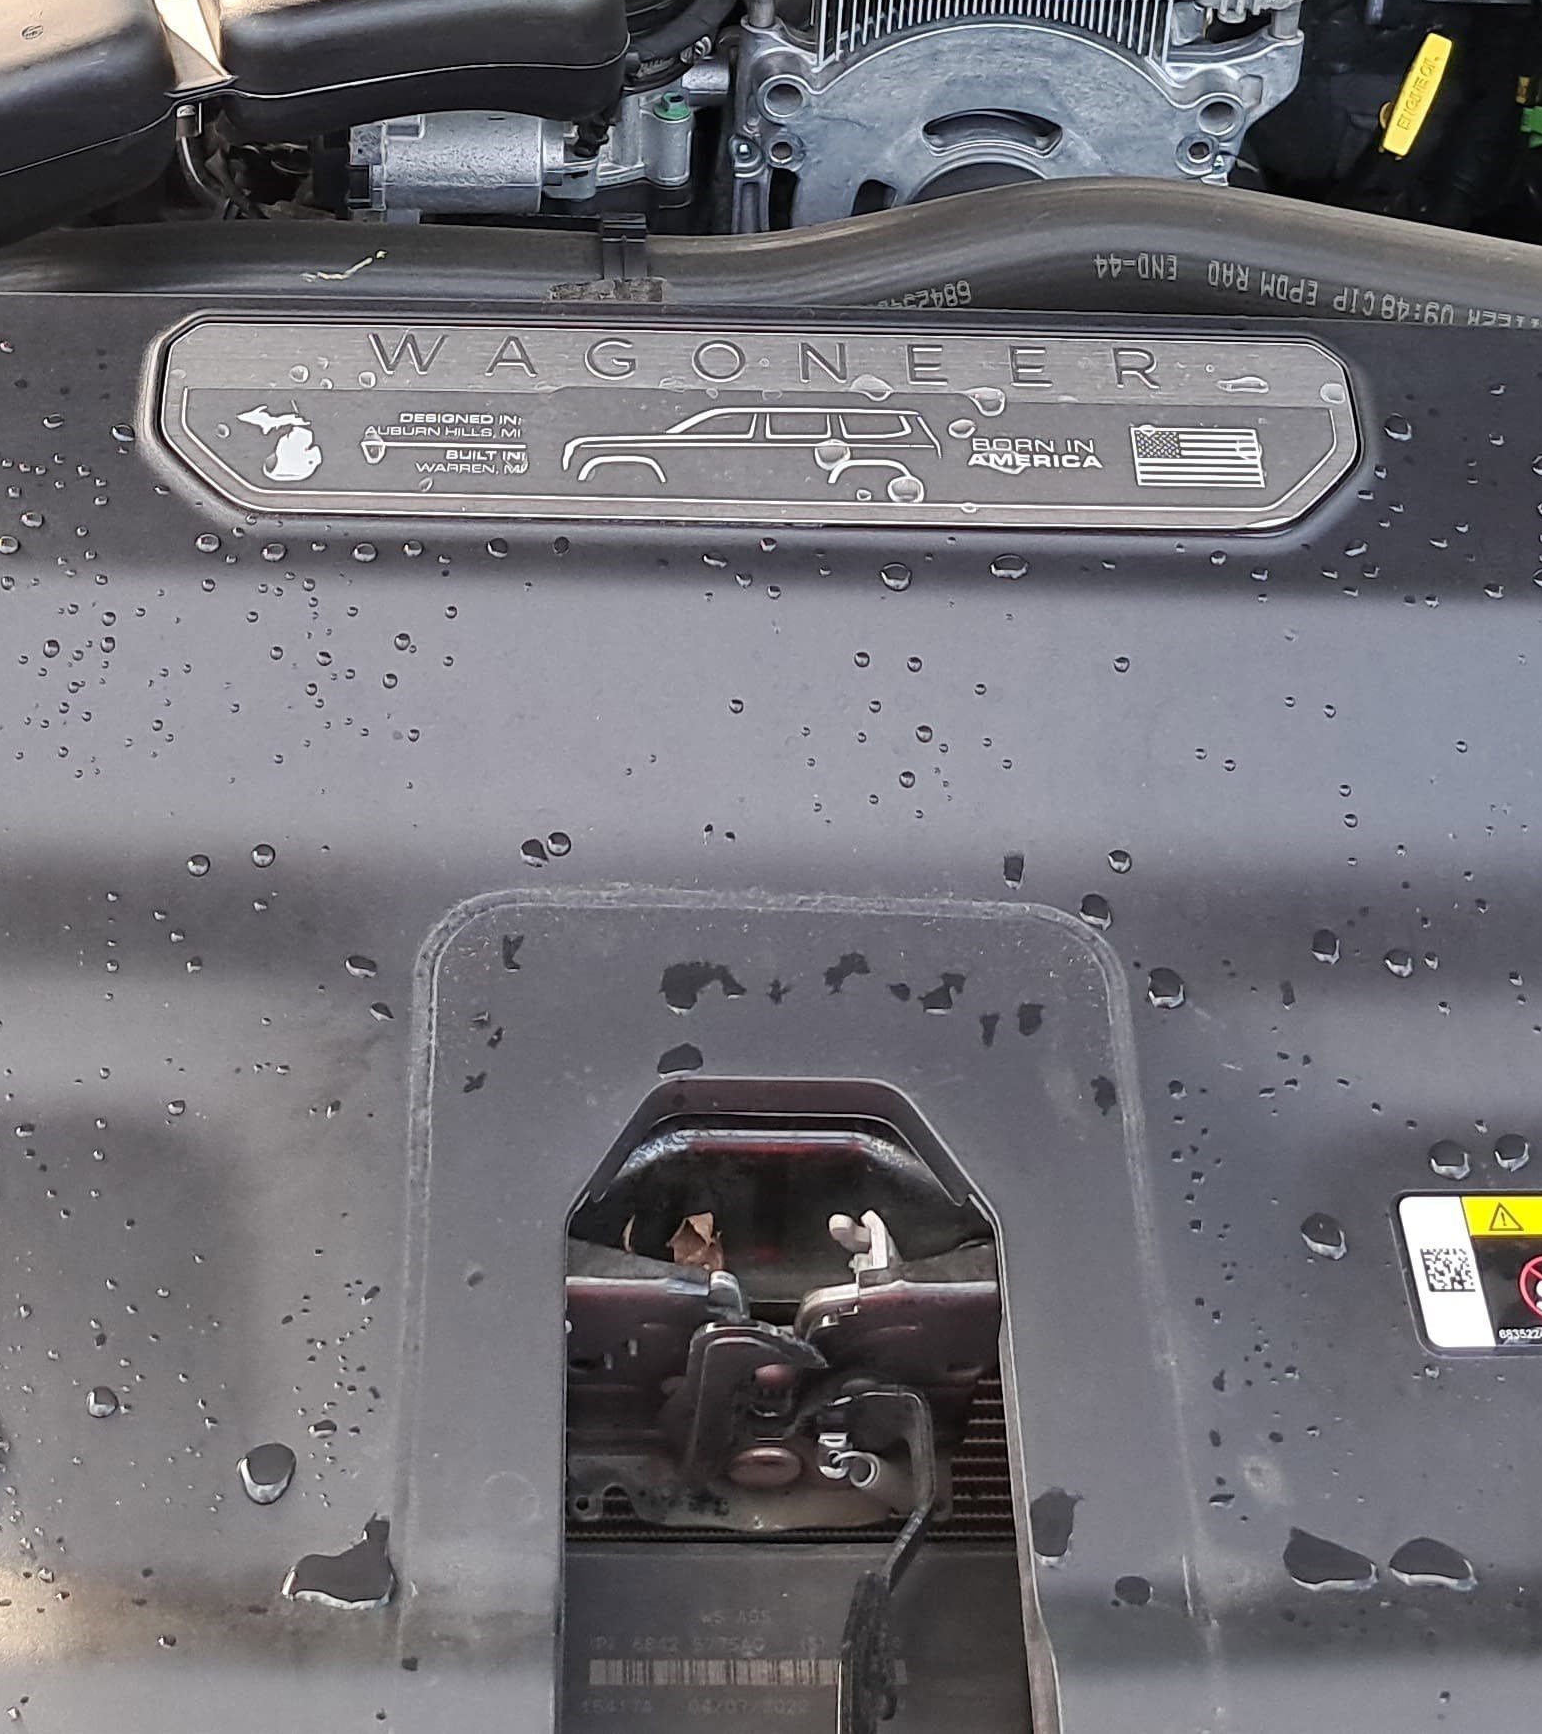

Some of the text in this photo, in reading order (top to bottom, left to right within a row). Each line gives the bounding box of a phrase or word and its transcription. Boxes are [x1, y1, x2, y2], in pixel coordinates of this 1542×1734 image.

[1206, 259, 1250, 292] RAD
[1260, 271, 1319, 306] EPDM
[369, 332, 1162, 389] WAGONEER
[399, 412, 494, 425] DESIGNED
[364, 425, 441, 437] AUBURN
[501, 428, 521, 439] MI
[971, 437, 1095, 454] BORN IN
[445, 449, 497, 461] BUILT
[967, 453, 1104, 469] AMERICA
